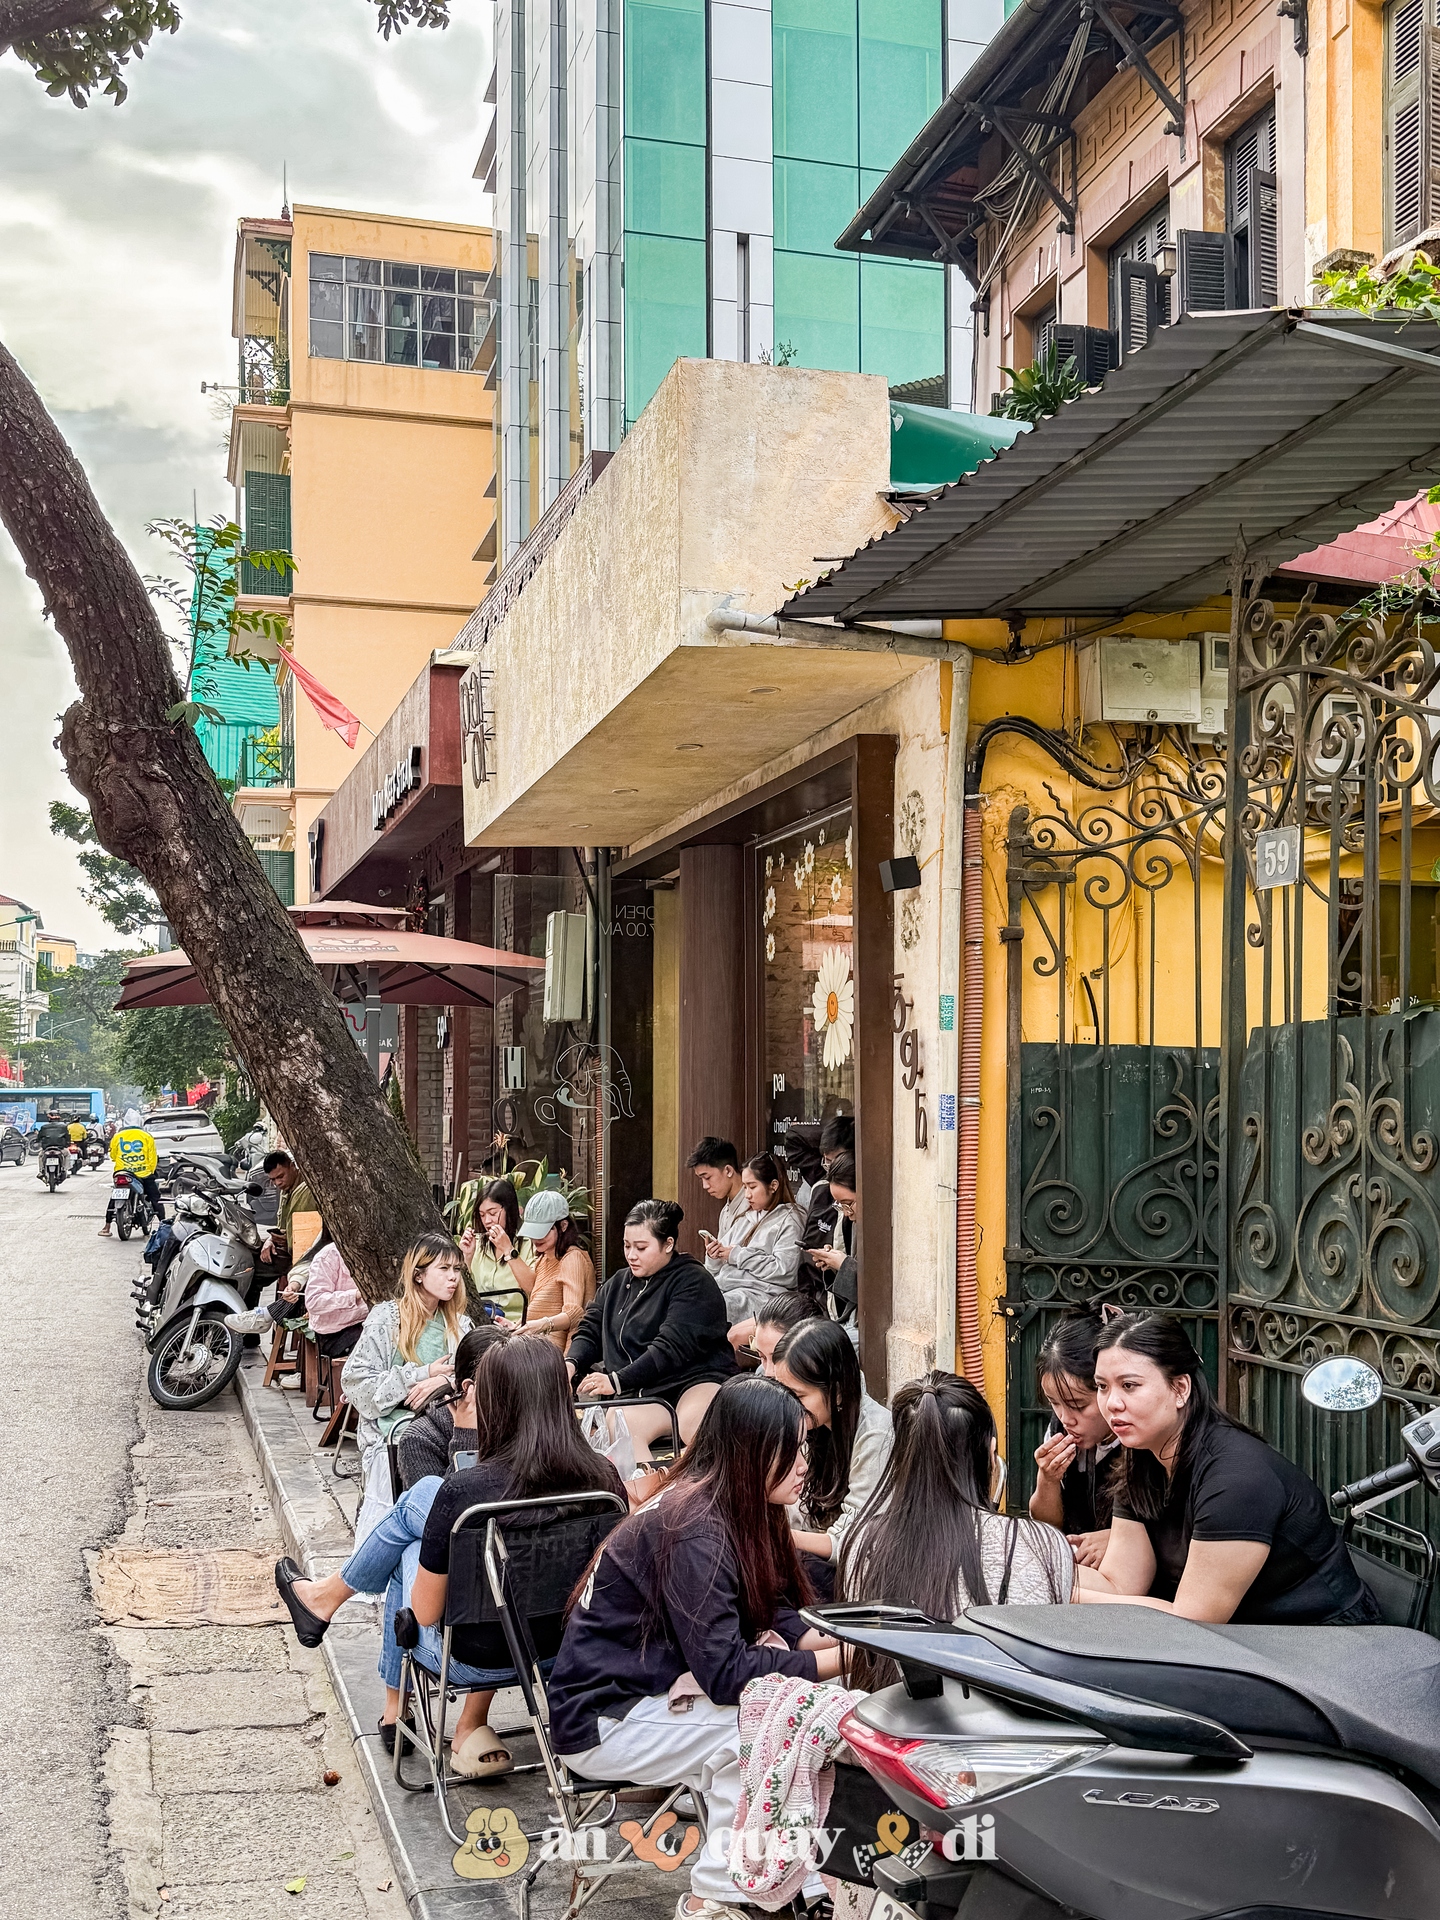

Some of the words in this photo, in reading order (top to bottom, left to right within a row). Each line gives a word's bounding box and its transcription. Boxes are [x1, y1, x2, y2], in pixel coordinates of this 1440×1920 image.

[1265, 839, 1289, 877] 59
[120, 1137, 144, 1153] be
[1082, 1788, 1220, 1814] LEAD
